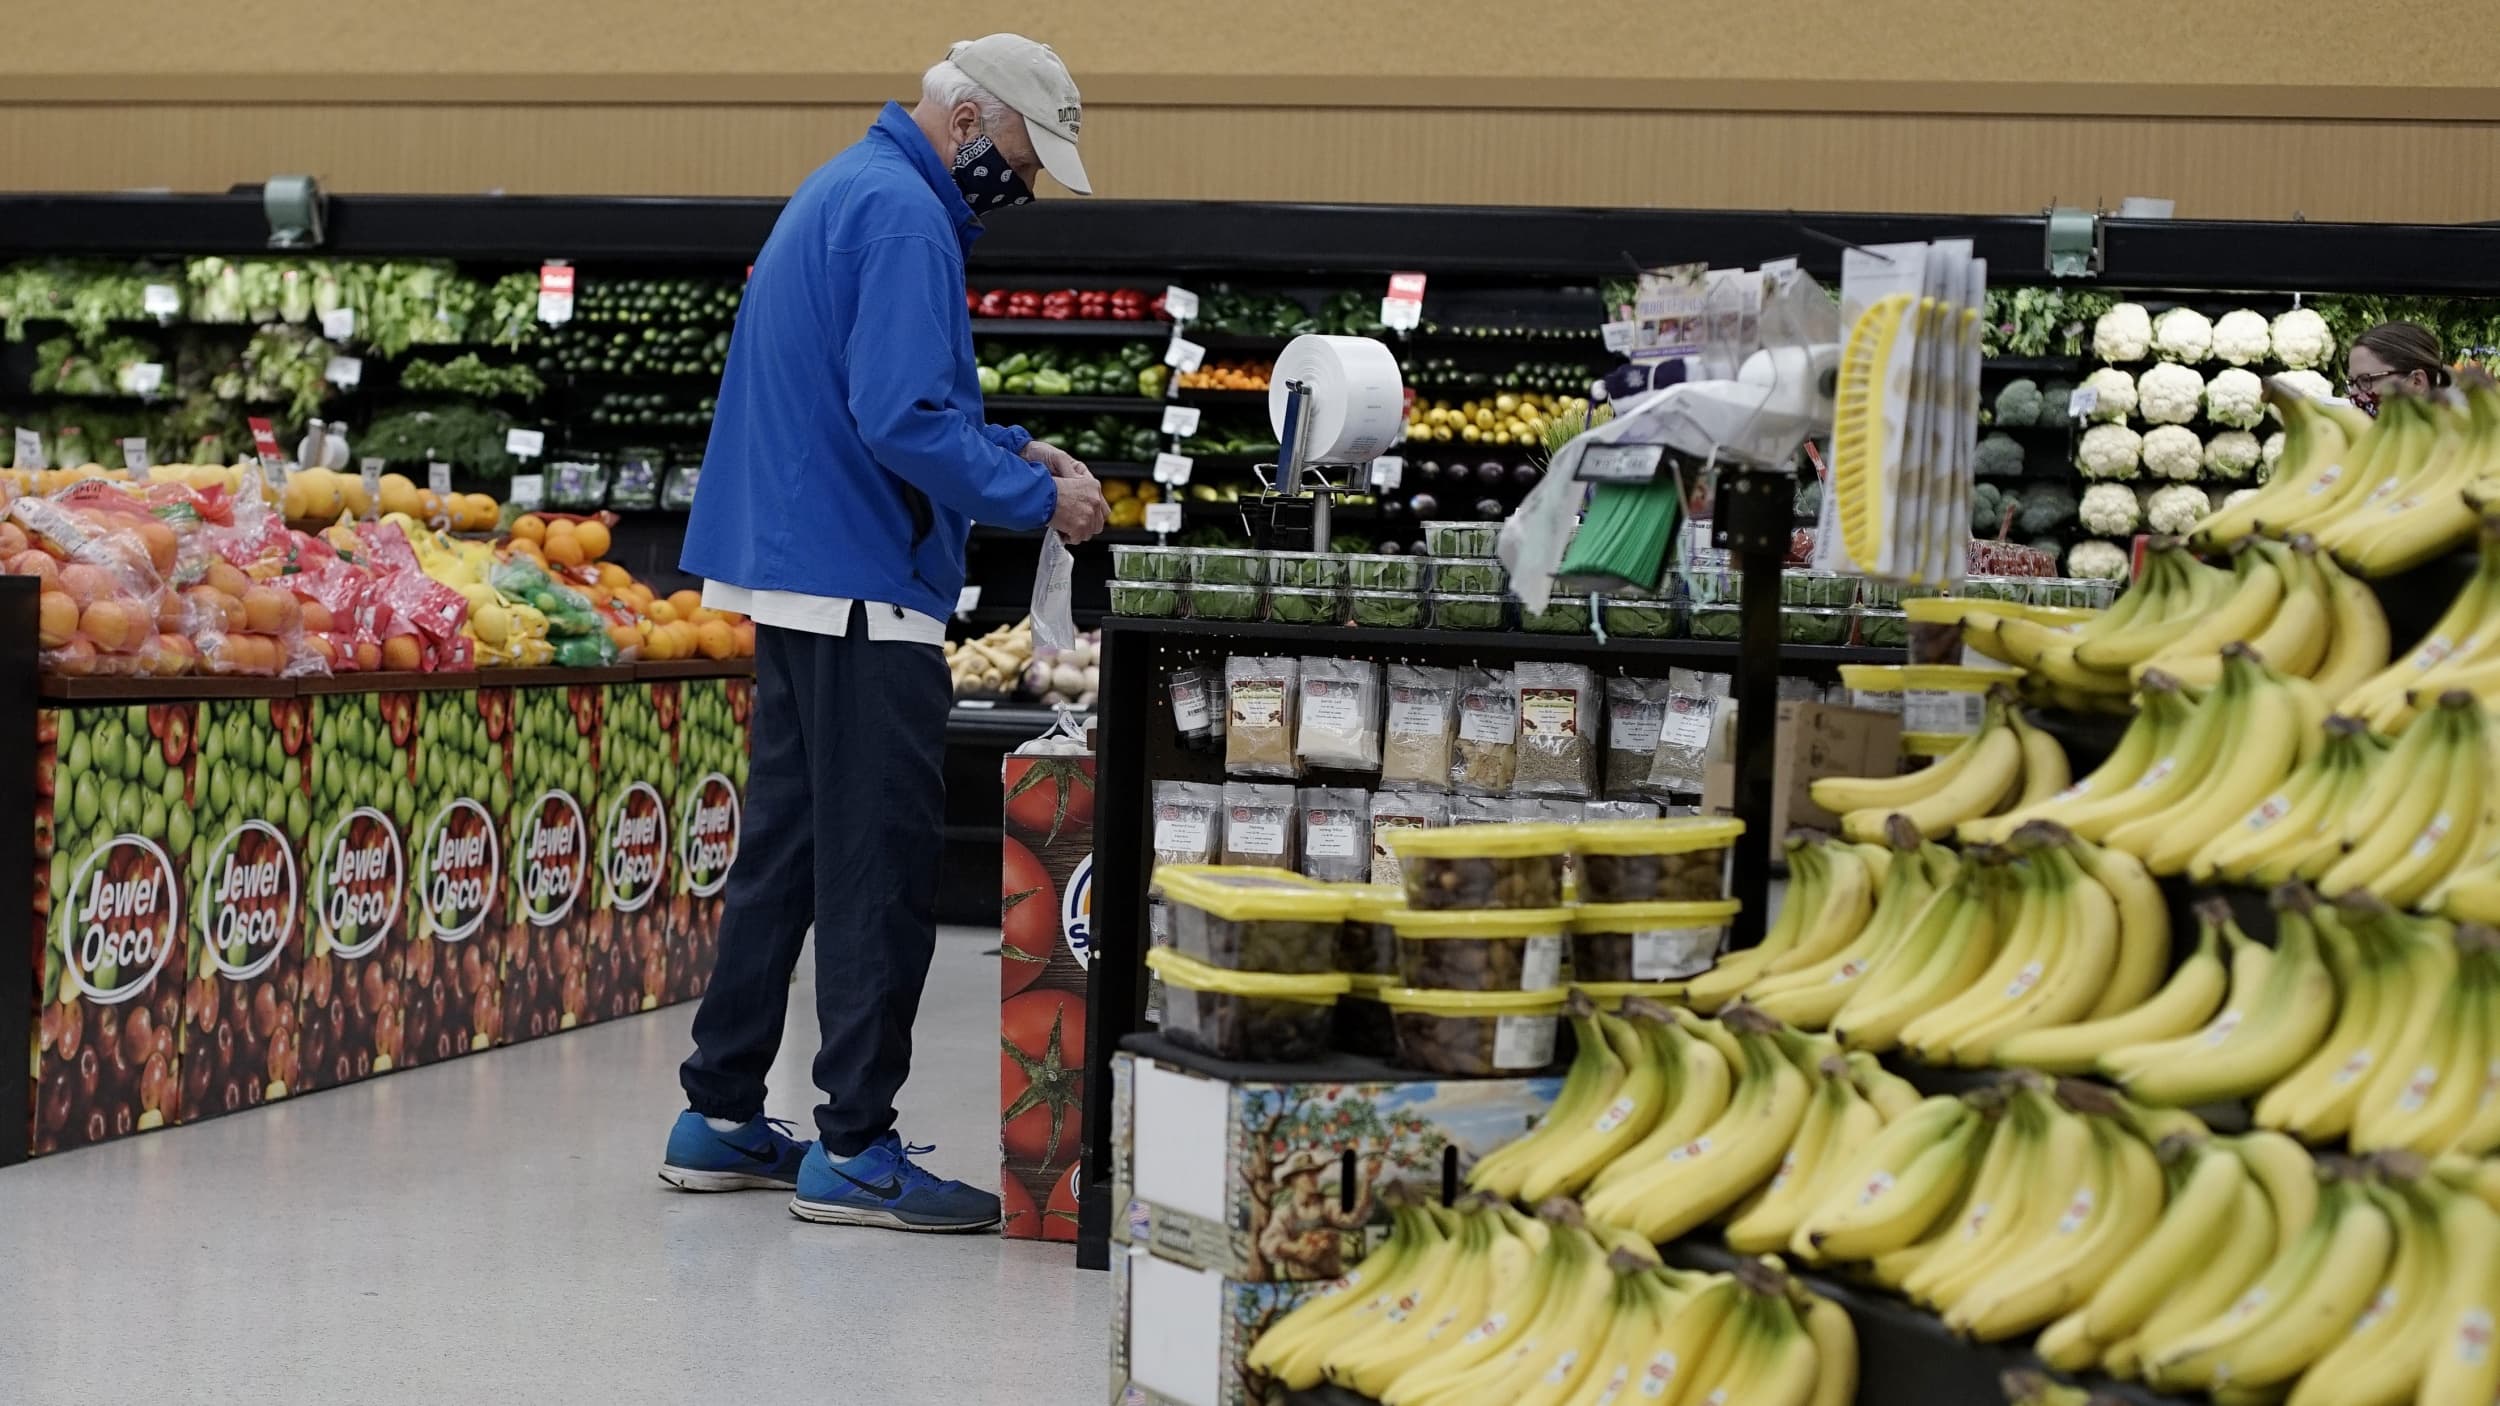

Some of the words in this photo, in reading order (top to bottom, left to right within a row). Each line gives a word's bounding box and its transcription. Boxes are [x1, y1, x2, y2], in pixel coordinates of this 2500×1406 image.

[613, 809, 656, 847] Jewel
[690, 800, 731, 835] Jewel
[432, 828, 485, 870] Jewel
[527, 818, 574, 858] Jewel
[689, 838, 727, 872] Osco
[215, 852, 281, 901] Jewel
[329, 838, 388, 884] Jewel
[527, 862, 571, 899] Osco
[612, 849, 651, 886] Osco
[80, 869, 159, 921] Jewel
[330, 887, 385, 930] Osco
[432, 874, 482, 914] Osco
[216, 905, 277, 950] Osco
[1069, 923, 1089, 948] S
[81, 924, 153, 972] Osco
